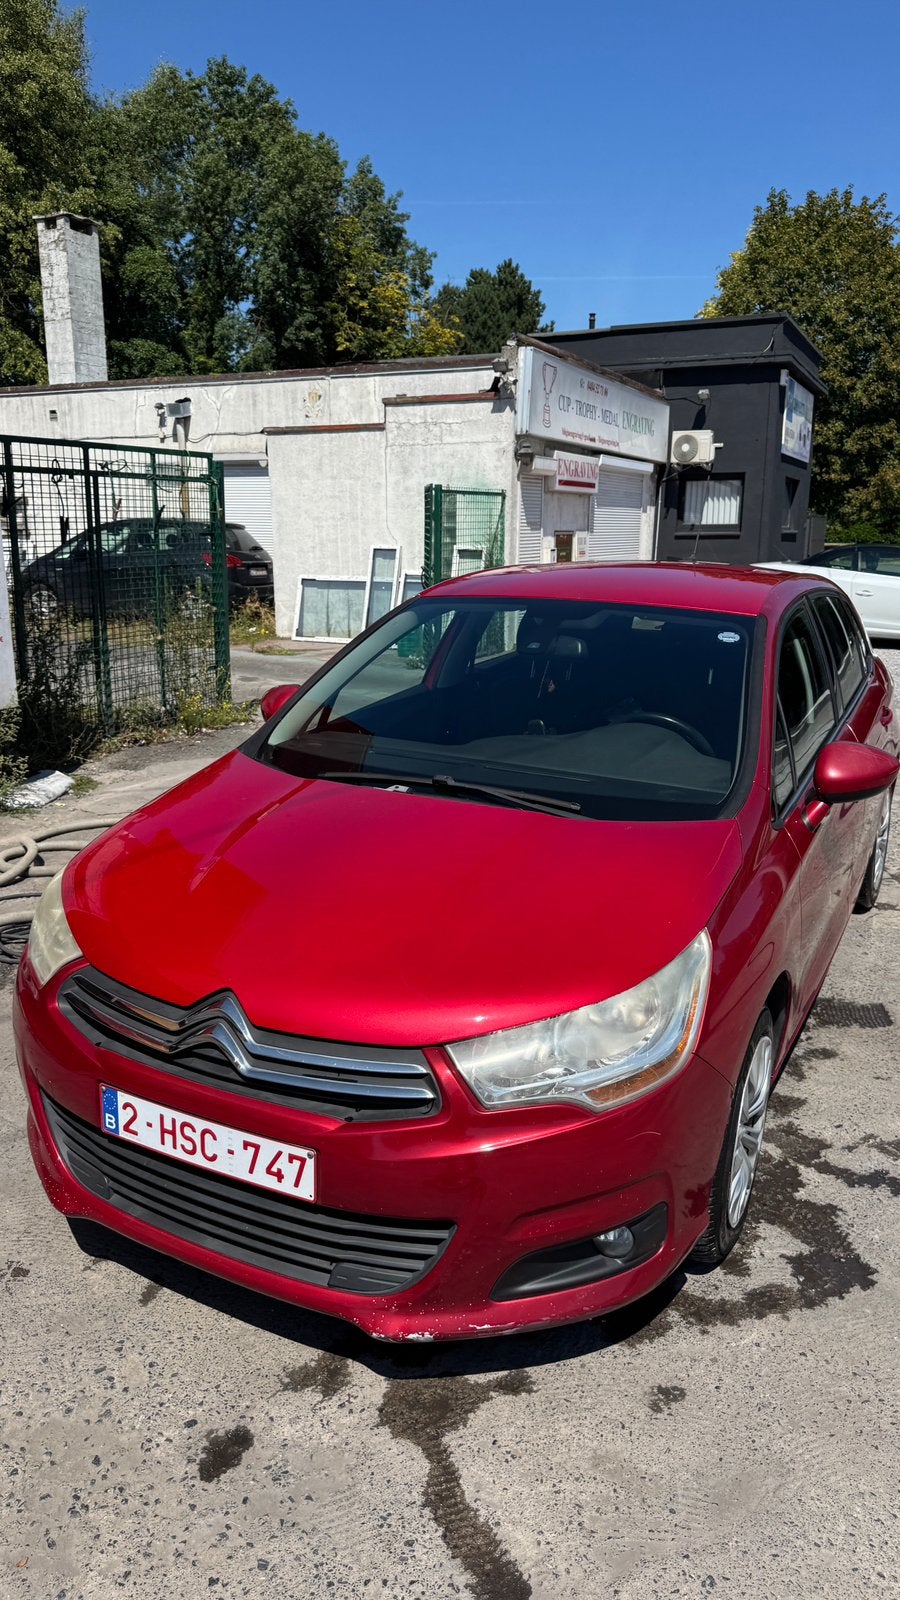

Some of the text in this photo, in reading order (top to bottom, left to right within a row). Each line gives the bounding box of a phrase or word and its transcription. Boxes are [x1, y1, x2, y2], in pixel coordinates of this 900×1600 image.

[558, 394, 572, 413] CUP
[575, 400, 598, 421] TROPHY
[601, 408, 620, 428] MEDAL
[622, 410, 655, 437] ENGRAVING
[557, 458, 599, 480] ENGRAVING
[105, 1113, 116, 1130] B
[121, 1101, 308, 1189] 2-HSC-747
